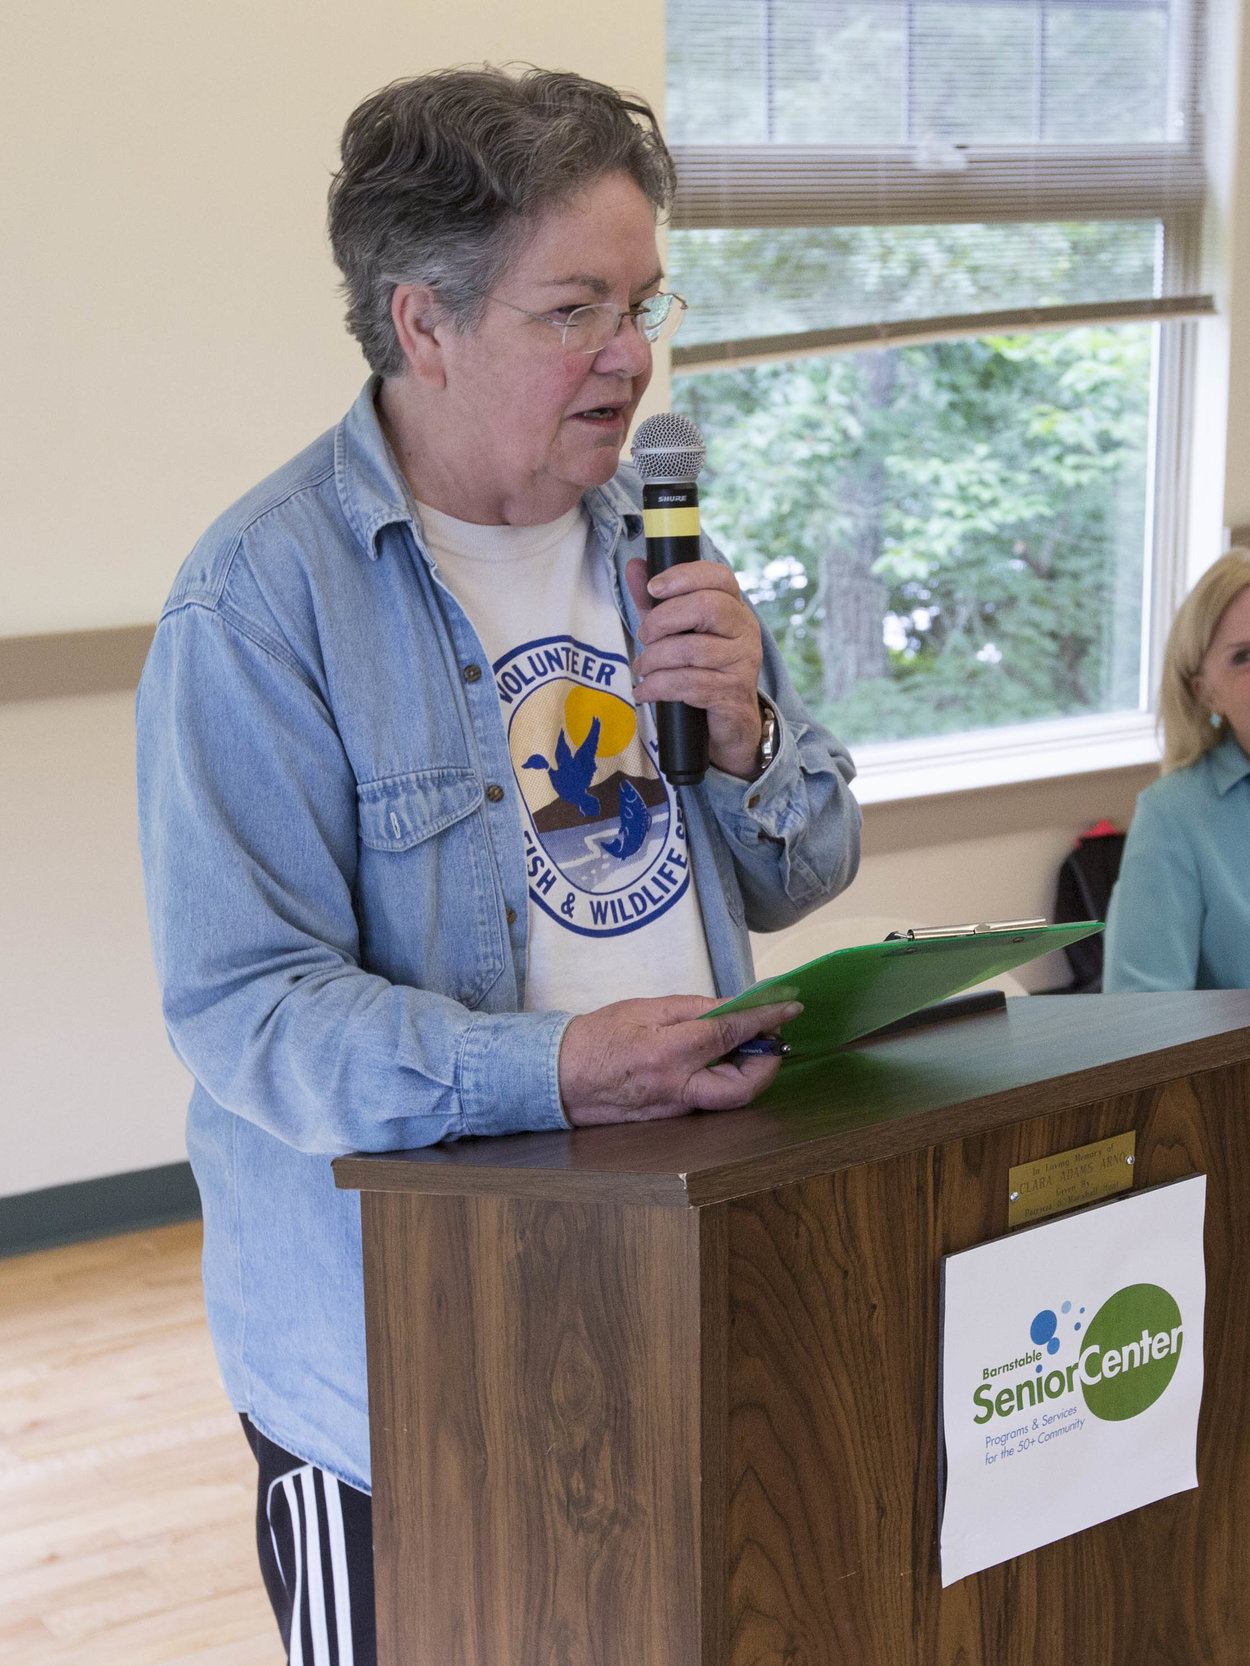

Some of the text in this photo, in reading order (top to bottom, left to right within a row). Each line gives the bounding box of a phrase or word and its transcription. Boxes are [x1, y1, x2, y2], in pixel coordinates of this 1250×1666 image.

[657, 494, 687, 503] SHURE
[560, 892, 576, 919] &
[590, 847, 689, 926] WILDLIFE
[1032, 1143, 1114, 1177] In Loving Memory of
[1020, 1174, 1052, 1196] CLARA
[1061, 1162, 1094, 1182] ADAMS
[1056, 1184, 1076, 1196] Given
[982, 1350, 1042, 1381] Barnstable
[985, 1406, 1077, 1448] Programs & Services
[985, 1418, 1086, 1466] for the 50+ Community
